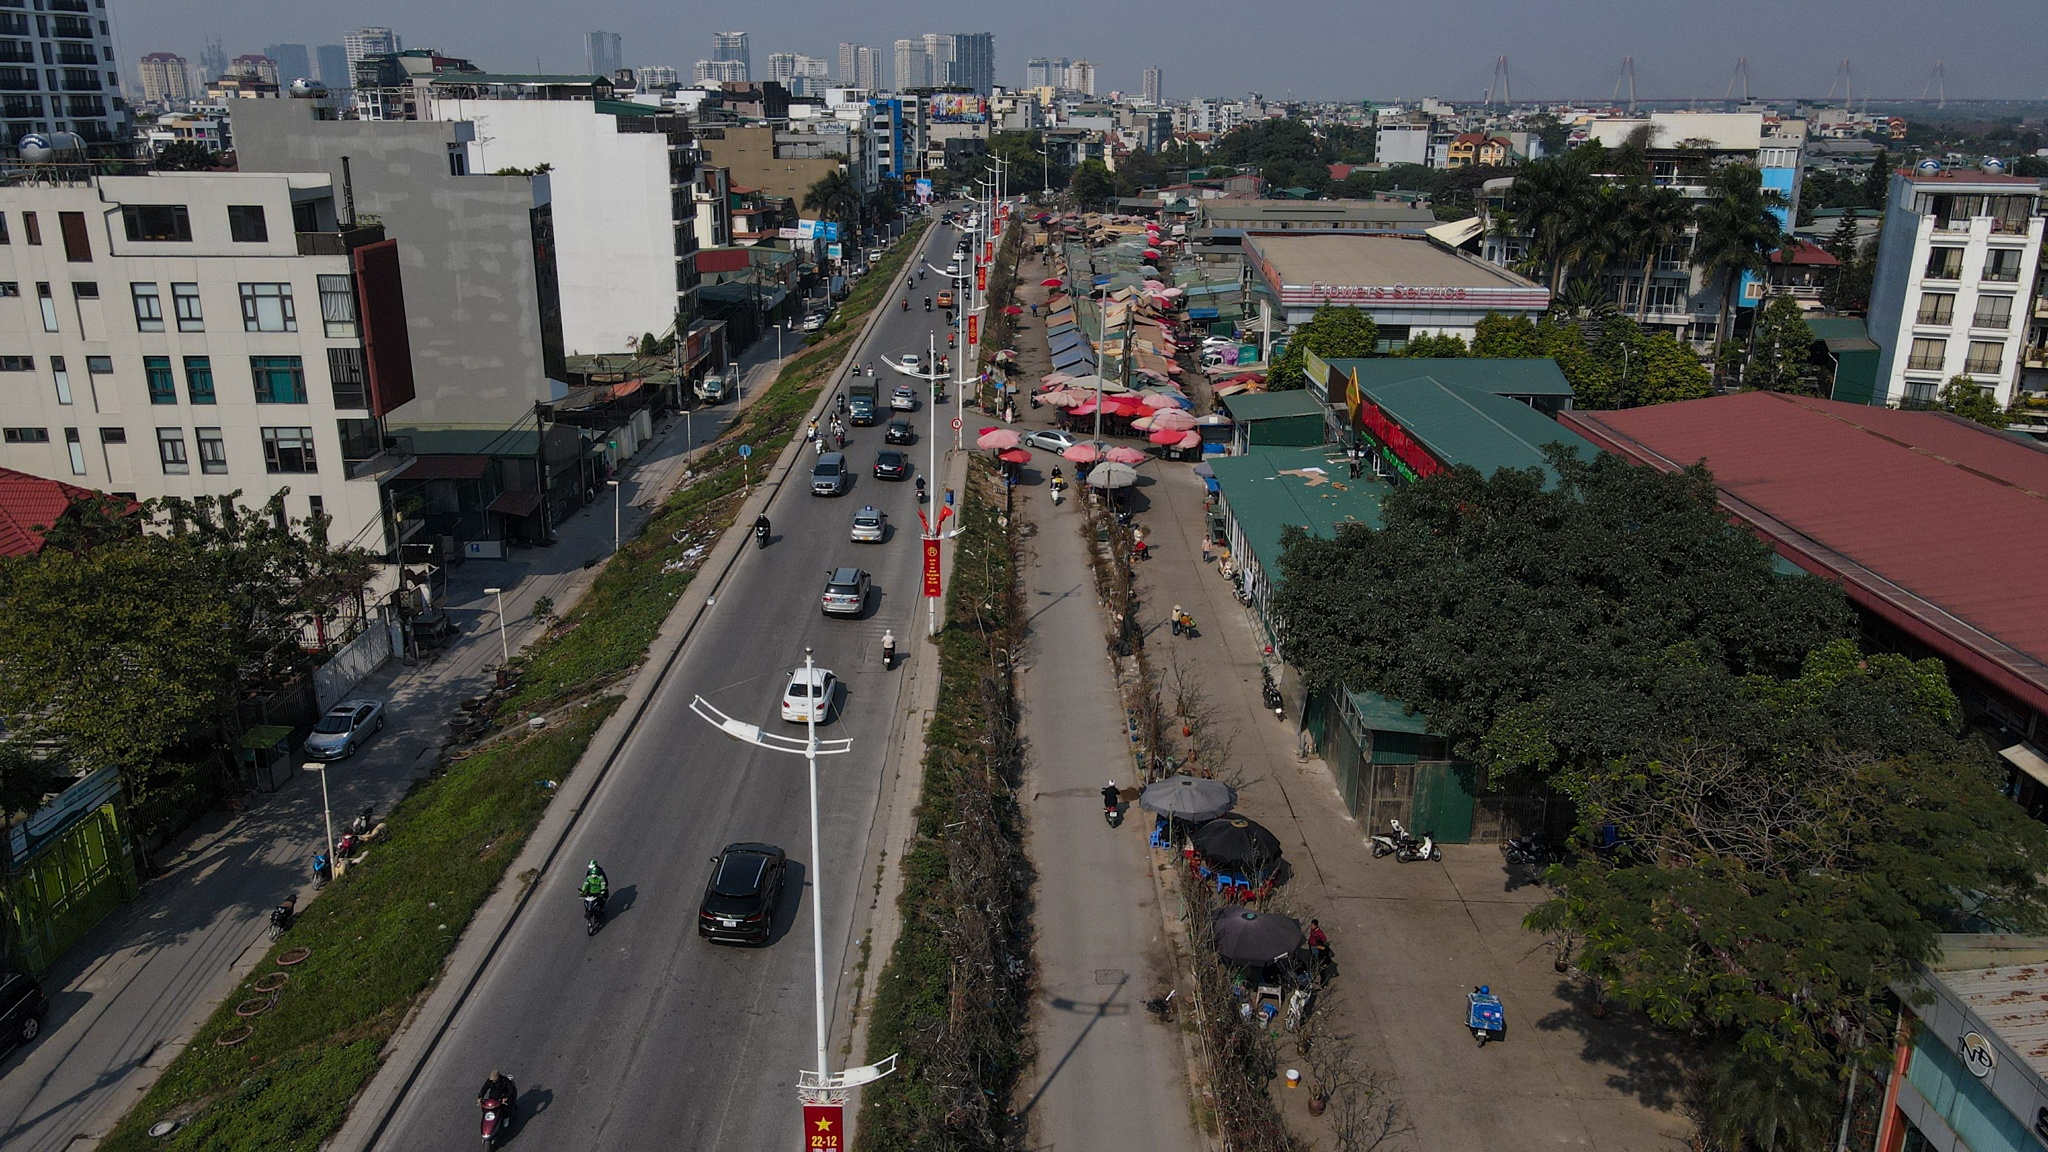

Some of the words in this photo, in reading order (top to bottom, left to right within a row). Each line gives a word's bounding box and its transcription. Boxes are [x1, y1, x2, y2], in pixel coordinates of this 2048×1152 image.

[1311, 280, 1385, 299] Flowers
[1392, 281, 1467, 299] Service
[811, 1135, 837, 1147] 22-12
